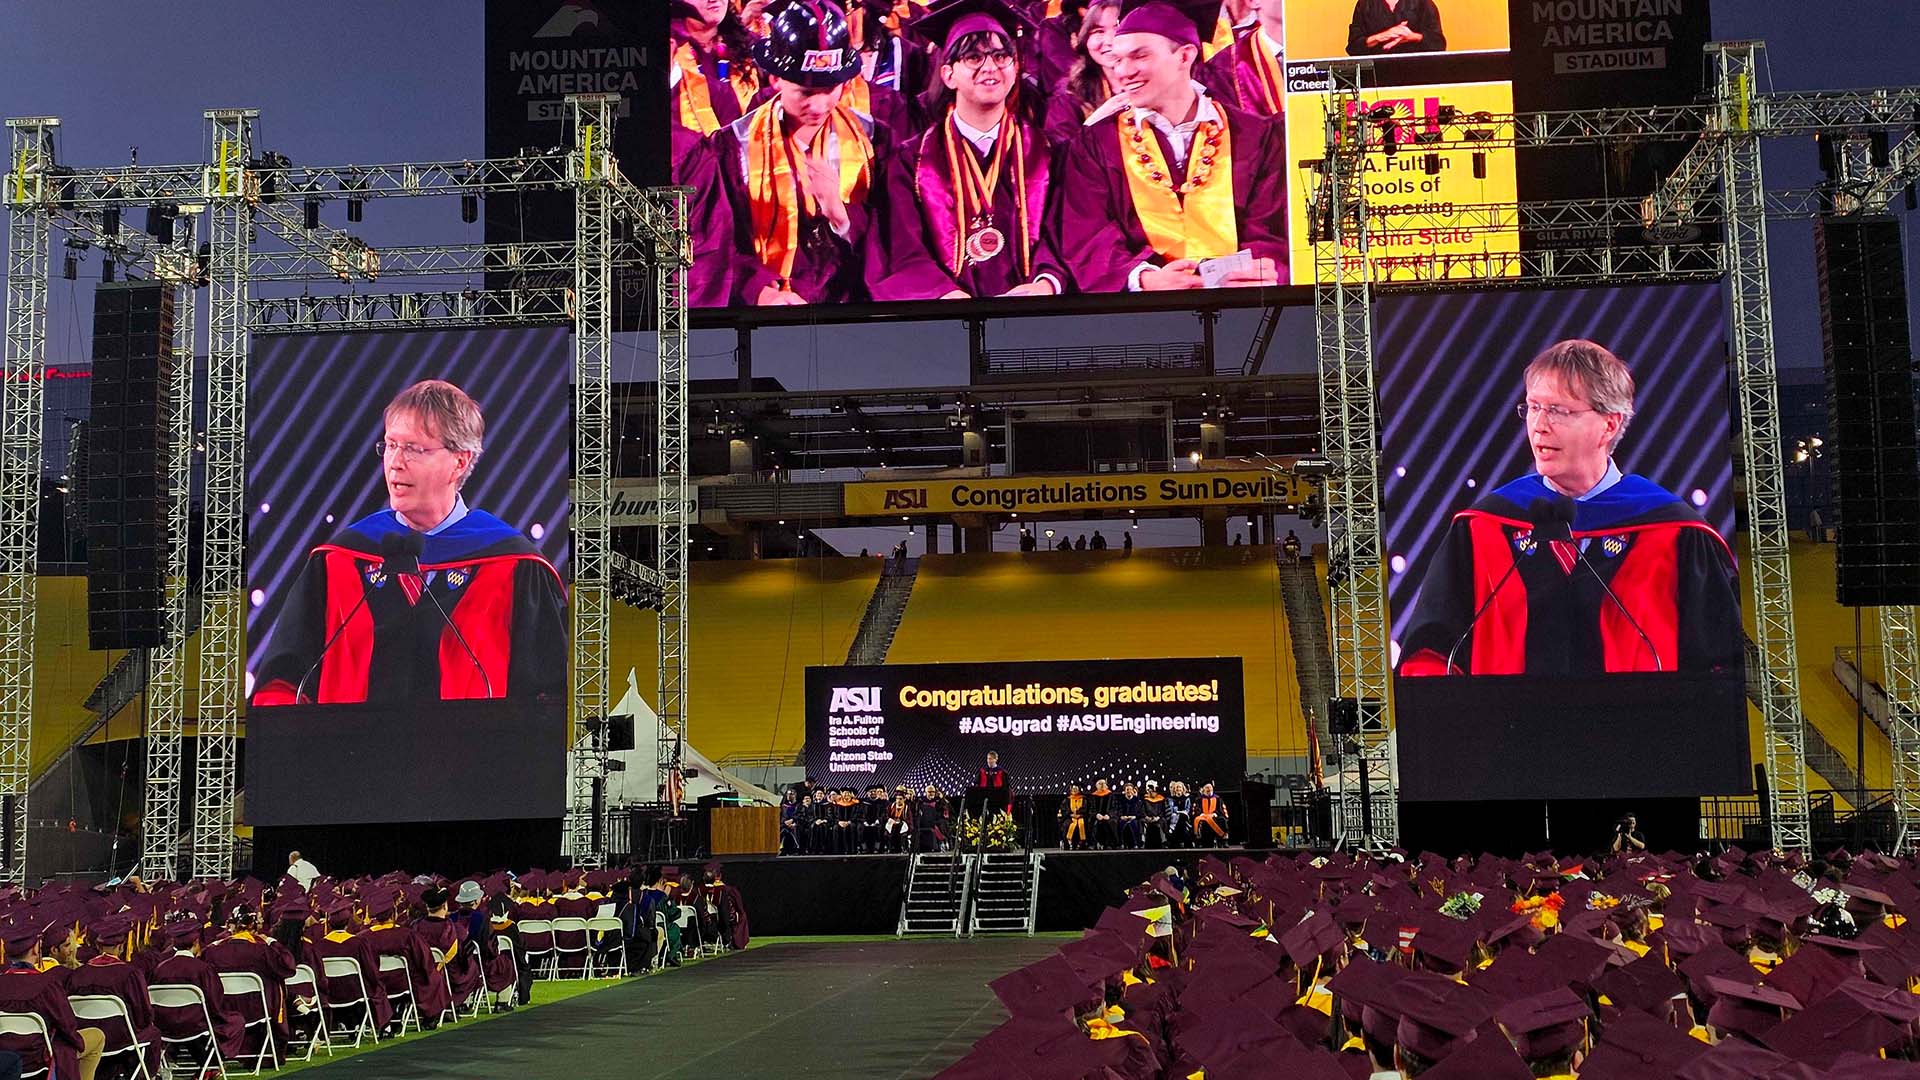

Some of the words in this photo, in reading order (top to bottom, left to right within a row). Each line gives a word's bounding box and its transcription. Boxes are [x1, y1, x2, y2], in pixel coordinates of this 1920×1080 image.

[1533, 0, 1682, 23] MOUNTAIN
[1542, 20, 1673, 47] AMERICA
[509, 47, 647, 71] MOUNTAIN
[801, 48, 843, 71] ASU
[1566, 52, 1654, 70] STADIUM
[517, 71, 639, 95] AMERICA
[1386, 155, 1450, 172] Fultn
[1420, 176, 1441, 192] of
[1419, 227, 1473, 246] State
[1536, 230, 1570, 242] GILA
[884, 489, 927, 510] ASU
[952, 482, 1147, 510] Congratulations
[1160, 478, 1208, 501] Sun
[1213, 475, 1298, 499] Devils!
[829, 687, 882, 712] ASU
[900, 683, 1089, 711] Congratulations,
[1094, 680, 1218, 708] graduates!
[829, 716, 842, 725] Ira
[843, 716, 853, 724] A.
[853, 715, 884, 724] Fulton
[959, 715, 1052, 736] #ASUgrad
[1056, 713, 1219, 734] #ASUEngineering
[829, 726, 867, 736] Schools
[869, 726, 879, 735] of
[829, 737, 885, 748] Engineering
[830, 752, 866, 761] Arizona
[867, 751, 893, 760] State
[830, 762, 877, 773] University
